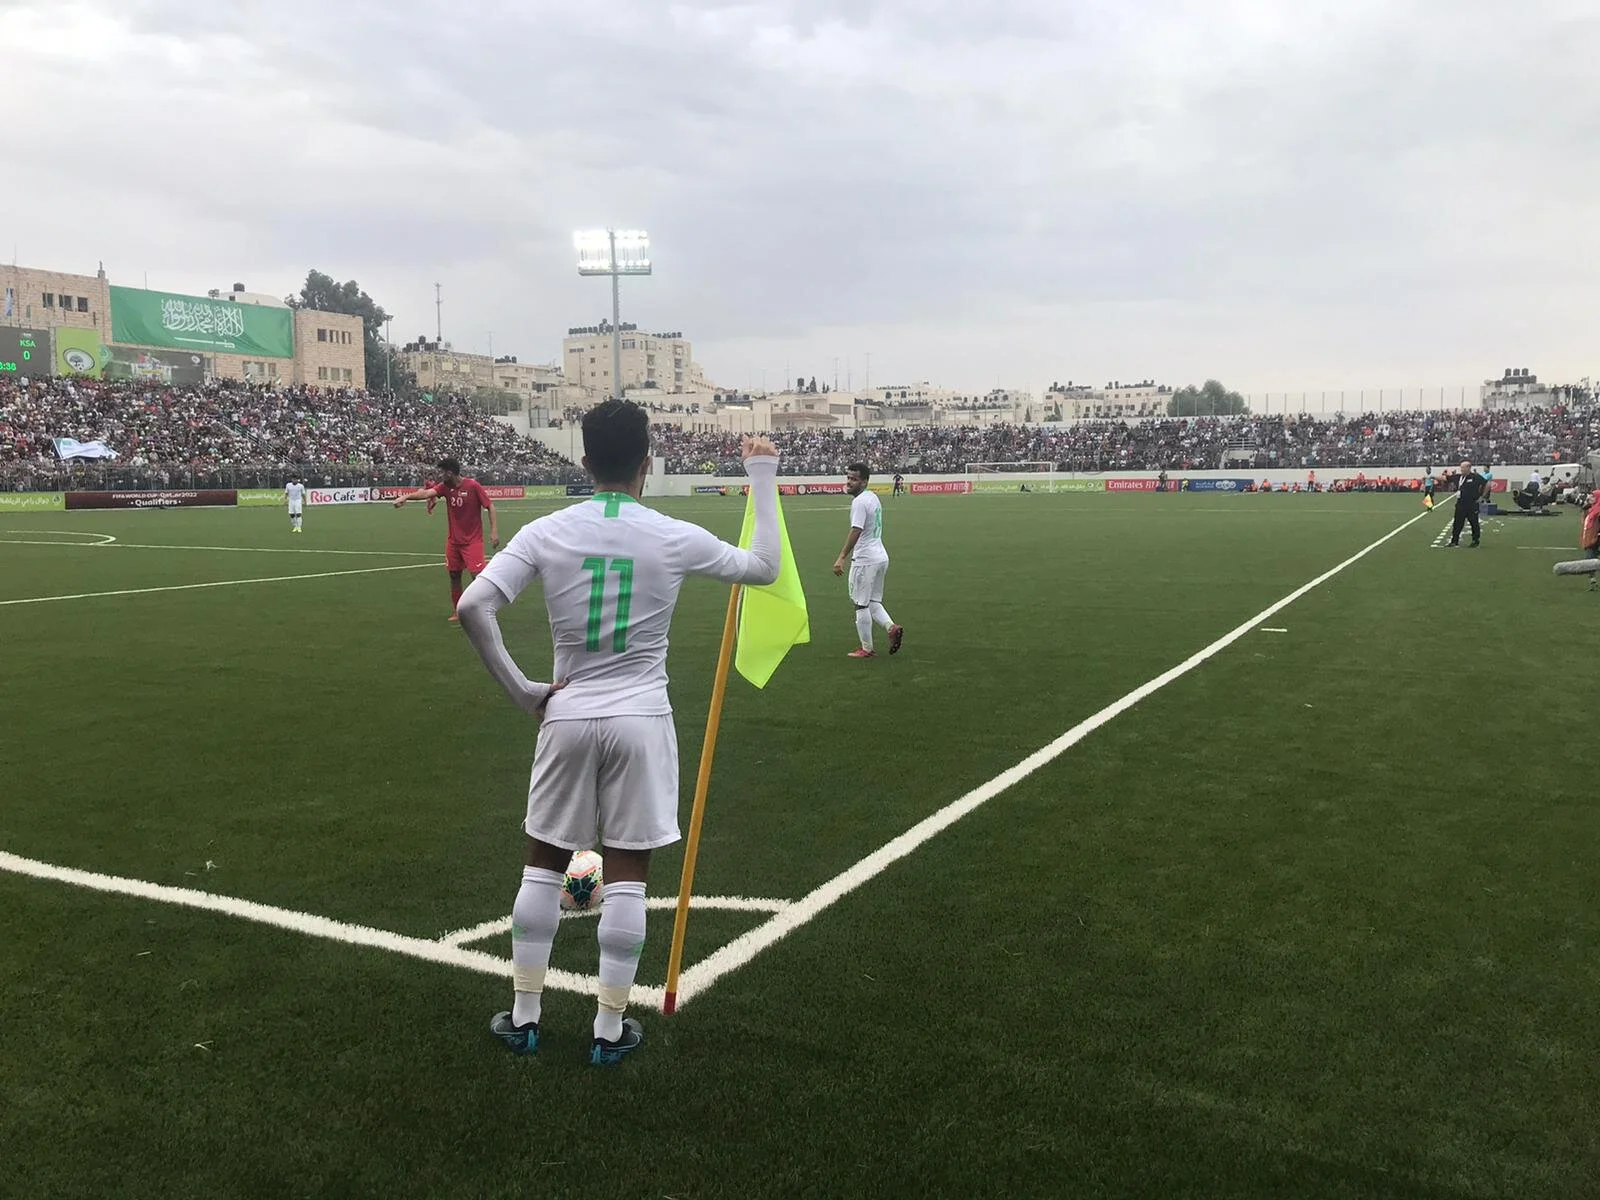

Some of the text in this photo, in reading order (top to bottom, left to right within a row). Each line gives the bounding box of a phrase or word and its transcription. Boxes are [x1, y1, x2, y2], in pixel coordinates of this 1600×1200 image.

[20, 339, 36, 348] KSA
[23, 350, 31, 360] 0
[912, 483, 943, 492] Emirates
[1108, 480, 1143, 489] Emirates
[310, 490, 332, 503] Rio
[333, 489, 356, 502] Café
[134, 498, 178, 507] Qualifiers
[451, 497, 463, 507] 20
[581, 556, 633, 652] 11
